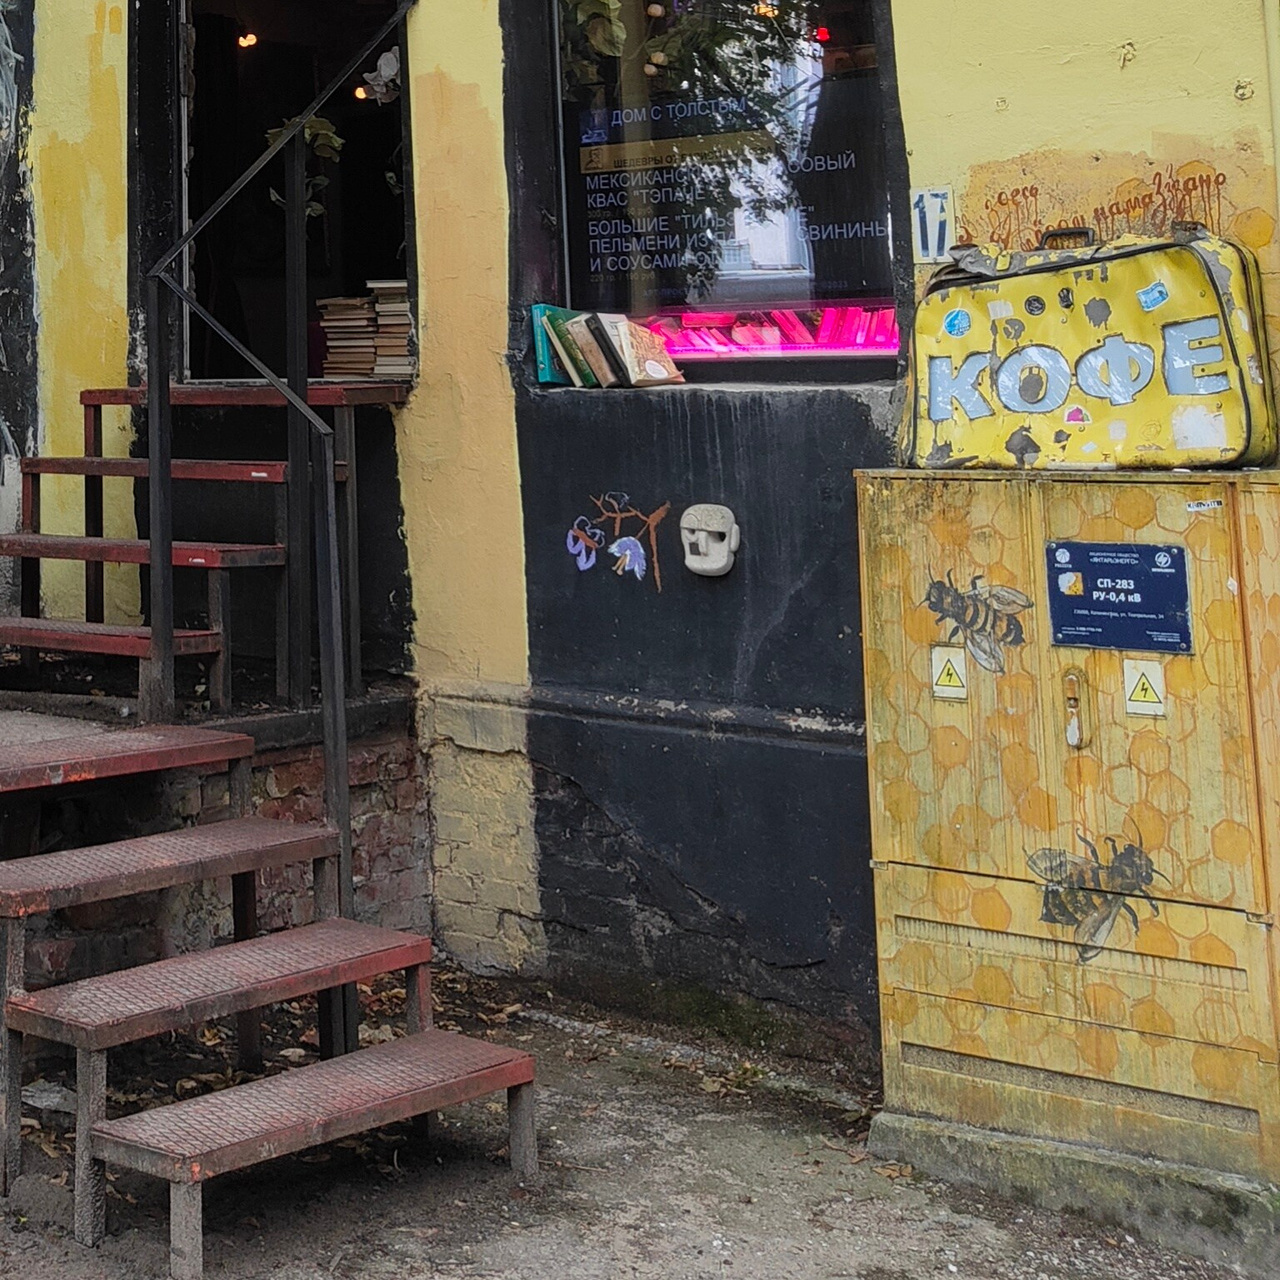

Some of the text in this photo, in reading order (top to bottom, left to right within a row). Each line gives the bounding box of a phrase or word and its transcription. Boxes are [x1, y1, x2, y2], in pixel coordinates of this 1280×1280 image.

[611, 96, 747, 127] ДОМ С ТОЛСТЫМ
[613, 154, 664, 169] ШЕДЕВРЫ
[586, 191, 628, 209] КВАС
[588, 215, 669, 236] БОЛЬШИЕ
[913, 192, 949, 258] 17
[589, 233, 680, 255] ПЕЛЬМЕНИ
[686, 231, 709, 249] ИЗ
[590, 257, 601, 272] И
[606, 252, 687, 271] СОУСАМИ
[928, 316, 1231, 421] КОФЕ
[1097, 578, 1135, 590] СП-283
[1092, 591, 1142, 603] РУ-0,4 кВ
